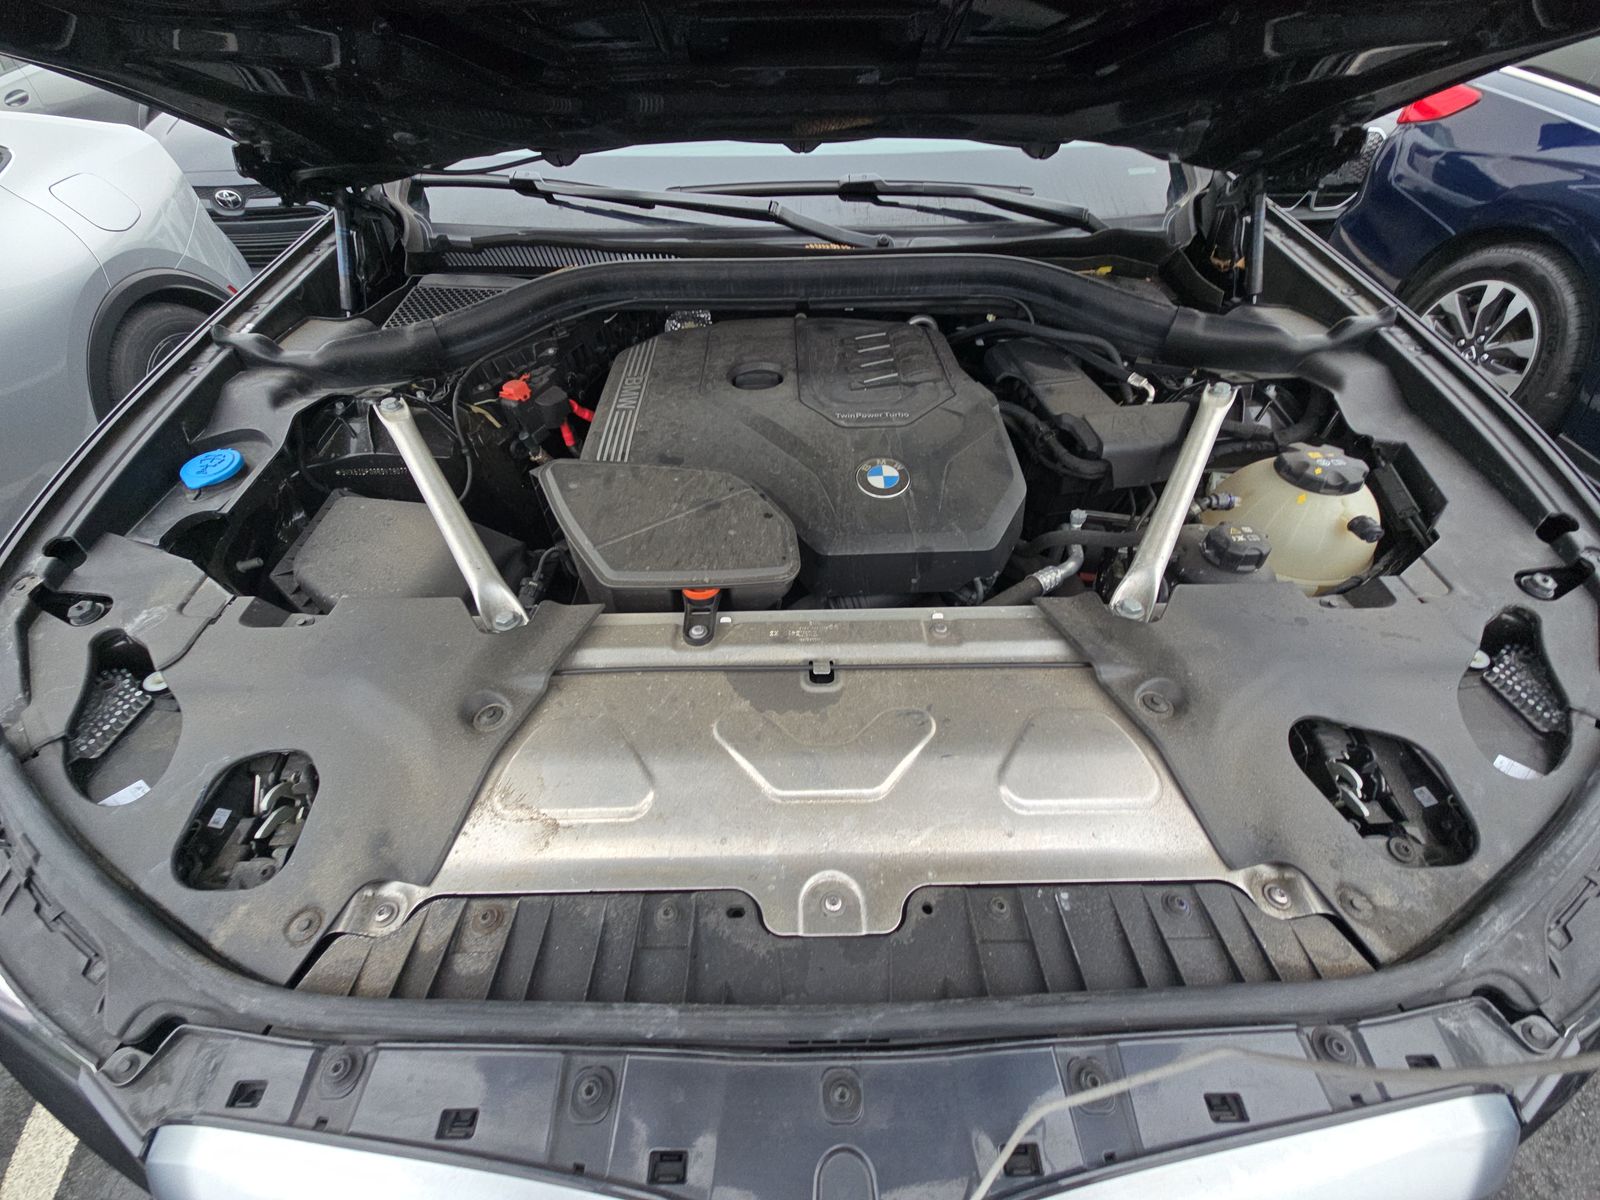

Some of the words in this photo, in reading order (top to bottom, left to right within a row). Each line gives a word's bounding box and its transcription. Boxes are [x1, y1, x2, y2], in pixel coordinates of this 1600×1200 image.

[616, 376, 644, 409] BMW
[835, 411, 883, 419] TwinPower
[885, 411, 910, 419] Turbo
[861, 458, 905, 472] BMW
